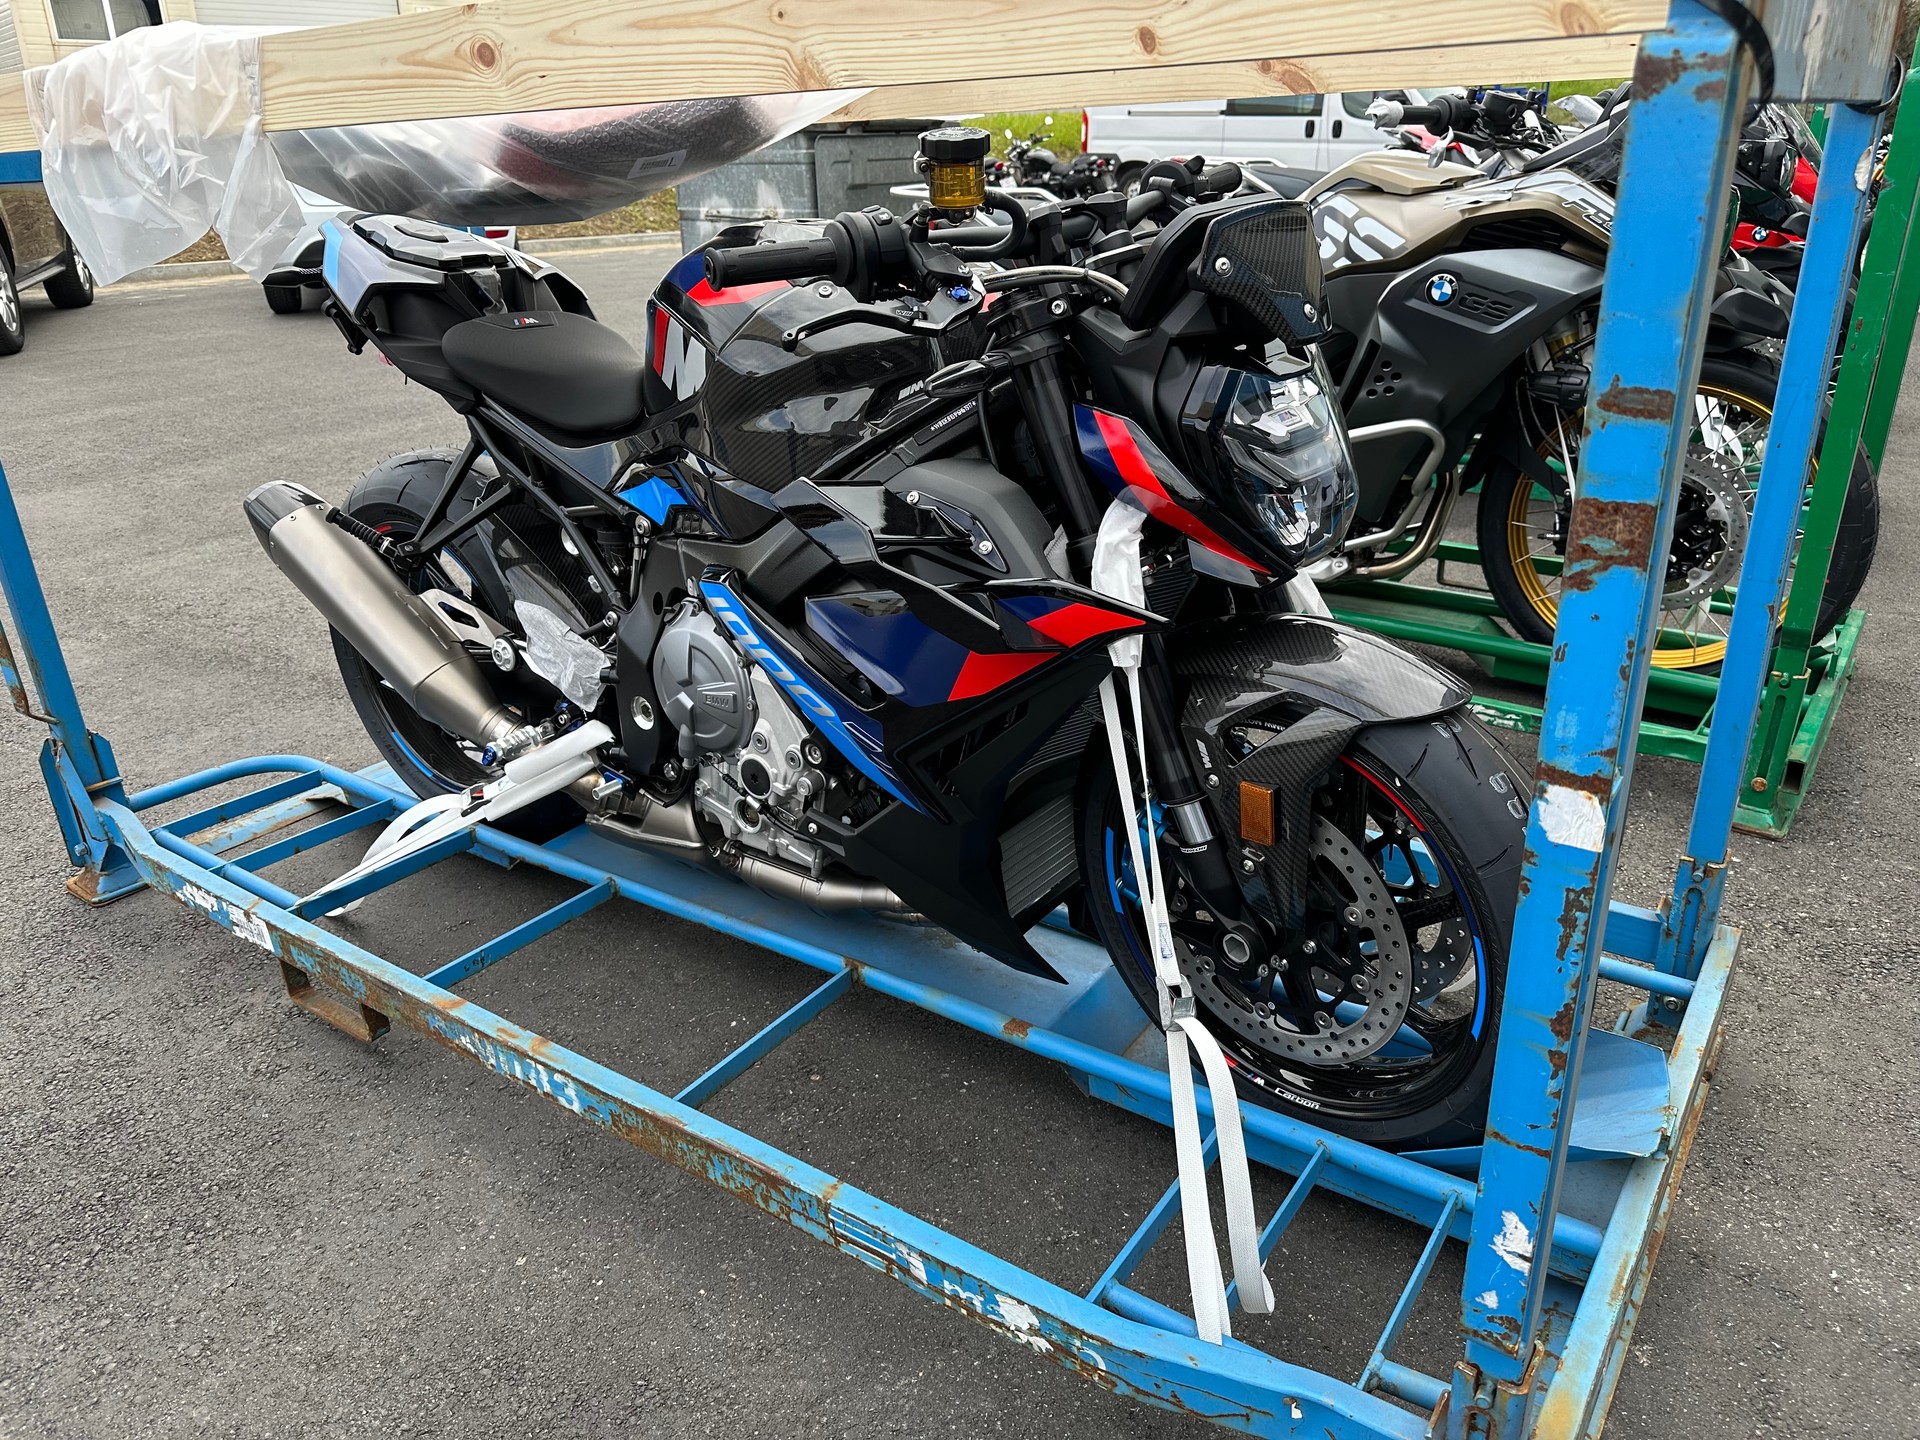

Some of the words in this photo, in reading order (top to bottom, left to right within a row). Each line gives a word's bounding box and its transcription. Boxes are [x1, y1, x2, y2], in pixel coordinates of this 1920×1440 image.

[1459, 293, 1514, 321] GS
[705, 694, 729, 708] BMW
[1274, 1087, 1321, 1110] Carbon
